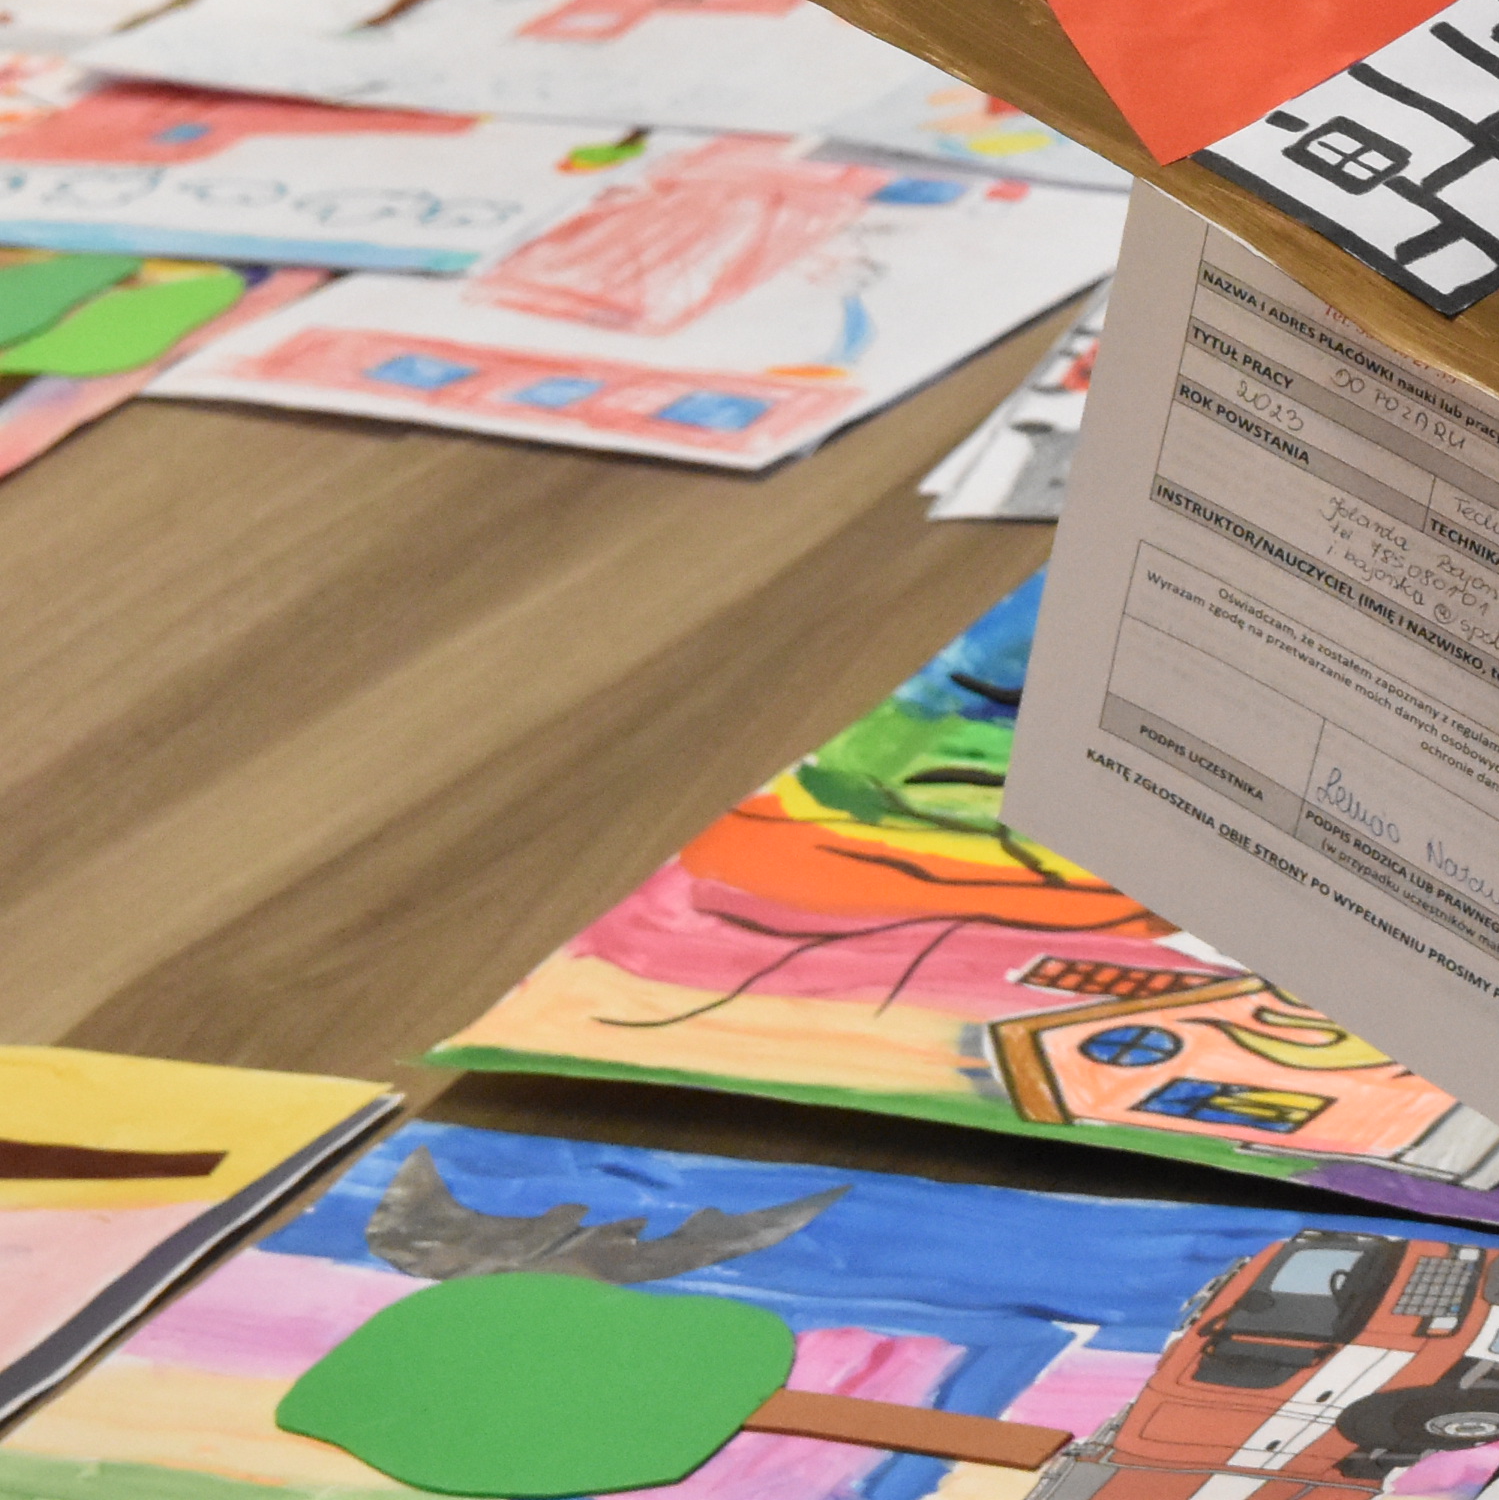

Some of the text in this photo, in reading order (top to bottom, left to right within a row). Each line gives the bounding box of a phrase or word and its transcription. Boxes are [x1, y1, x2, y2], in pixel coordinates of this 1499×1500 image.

[1191, 324, 1294, 389] TYTUŁ PRACY
[1202, 268, 1257, 308] NAZWA
[1267, 306, 1316, 339] ADRES
[1317, 331, 1394, 383] PLACÓWKI
[1396, 377, 1437, 406] nauki
[1438, 397, 1463, 419] lub
[1178, 383, 1310, 465] ROK POWSTANIA
[1235, 378, 1305, 432] 2023
[1155, 483, 1355, 600] INSTRUKTOR/NAUCZYCIEL
[1357, 592, 1396, 625] (IMIĘ
[1397, 614, 1403, 626] I
[1405, 618, 1486, 675] NAZWISKO,
[1207, 601, 1246, 630] zgodę
[1246, 623, 1264, 638] na
[1264, 633, 1353, 687] przetwarzanie
[1353, 682, 1392, 710] moich
[1393, 705, 1438, 737] danych
[1217, 586, 1297, 641] Oświadczam,
[1316, 642, 1373, 680] zostałem
[1373, 675, 1440, 720] zapoznany
[1440, 713, 1449, 724] z
[1138, 723, 1264, 801] PODPIS UCZESTNIKA
[1419, 739, 1475, 777] ochronie
[1085, 747, 1131, 782] KARTĘ
[1132, 772, 1215, 829] ZGŁOSZENIA
[1217, 822, 1252, 852] OBIE
[1251, 842, 1309, 882] STRONY
[1309, 876, 1330, 896] PO
[1332, 889, 1426, 954] WYPEŁNIENIU
[1426, 946, 1492, 992] PROSIMY
[1304, 808, 1351, 844] PODPIS
[1351, 837, 1407, 879] RODZICA
[1408, 871, 1434, 894] LUB
[1335, 850, 1400, 893] przypadku
[1401, 889, 1476, 938] uczestników
